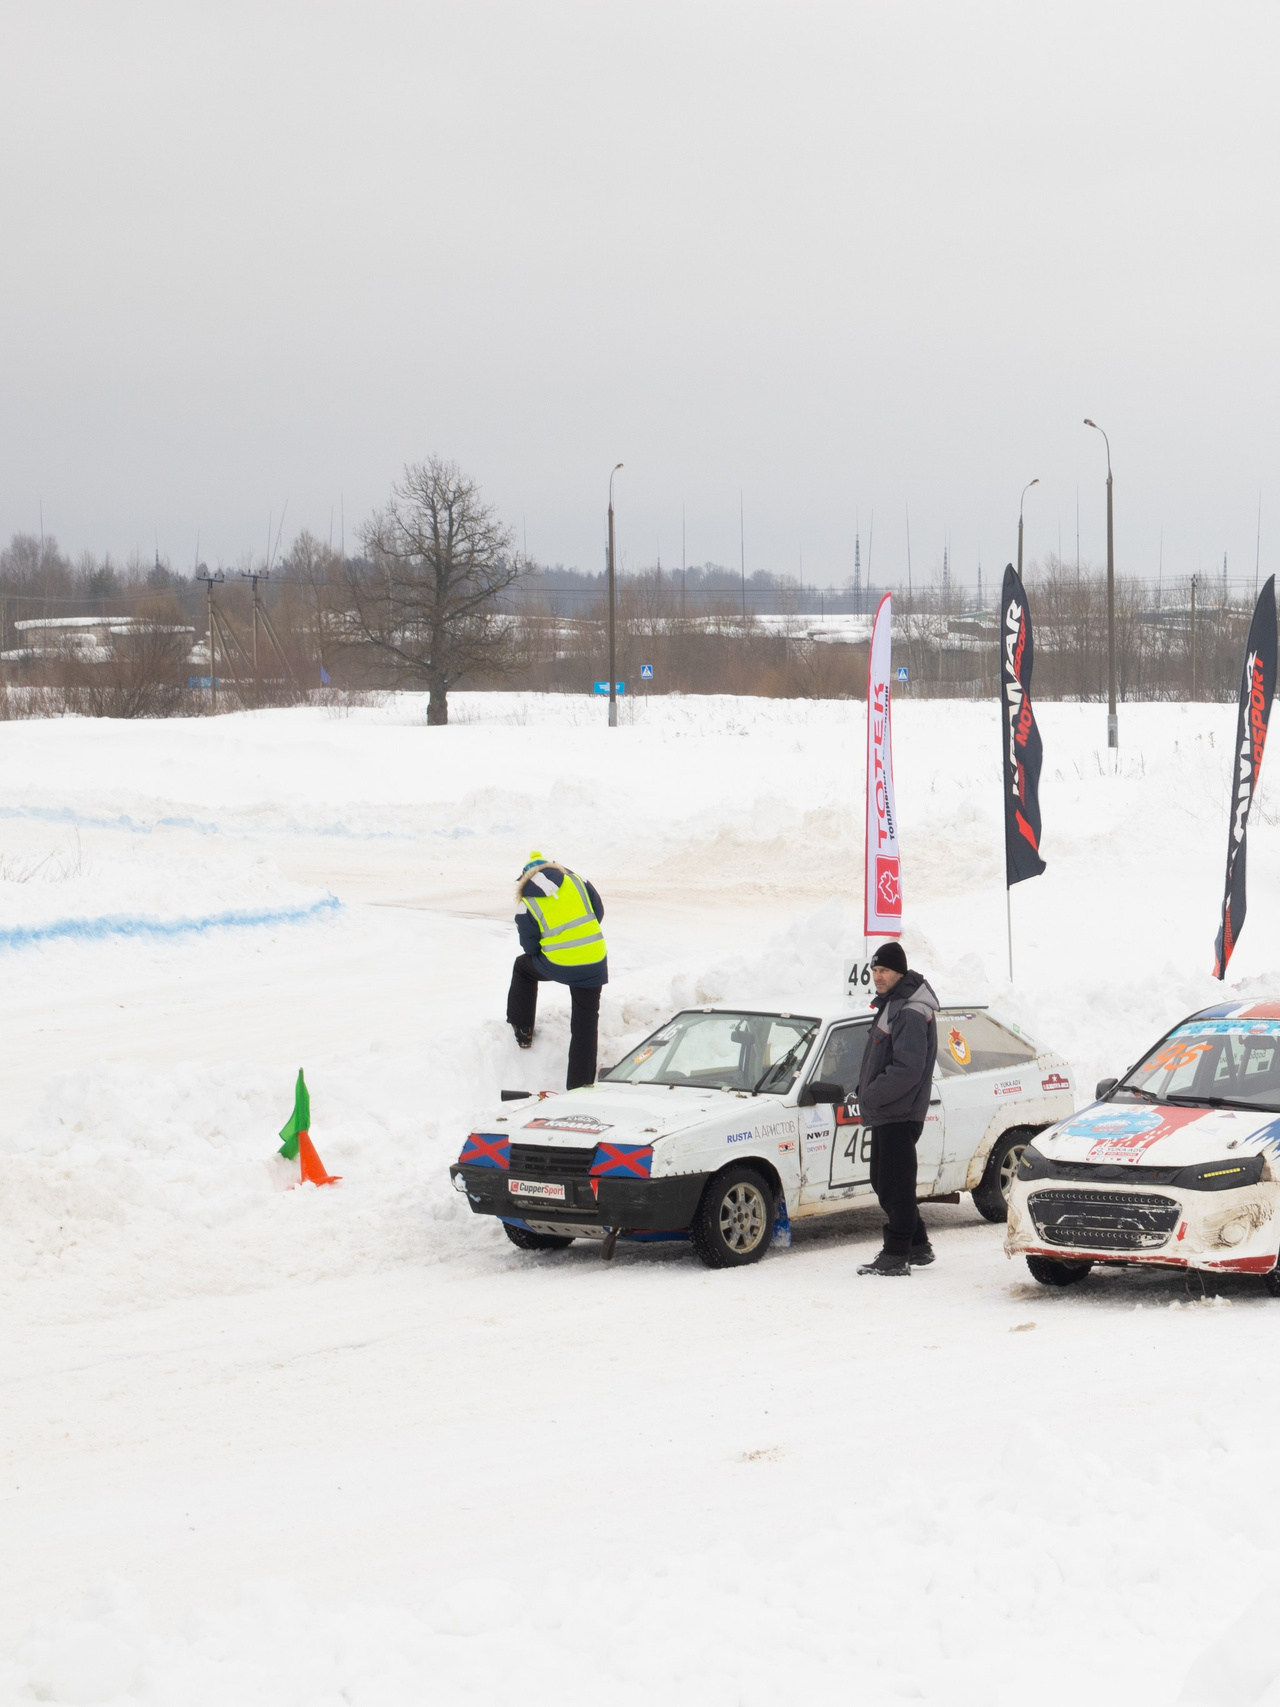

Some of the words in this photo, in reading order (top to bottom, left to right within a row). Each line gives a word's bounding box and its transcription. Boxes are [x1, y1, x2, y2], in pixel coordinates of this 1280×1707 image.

[1005, 599, 1022, 796] KMAR
[848, 963, 871, 986] 46
[657, 1024, 683, 1040] 46
[1144, 1043, 1214, 1071] 95
[544, 1120, 610, 1131] KRAMAR
[726, 1131, 753, 1144] RUSTA
[806, 1130, 830, 1140] NWB
[844, 1128, 872, 1164] 46
[519, 1181, 563, 1196] CupperSport
